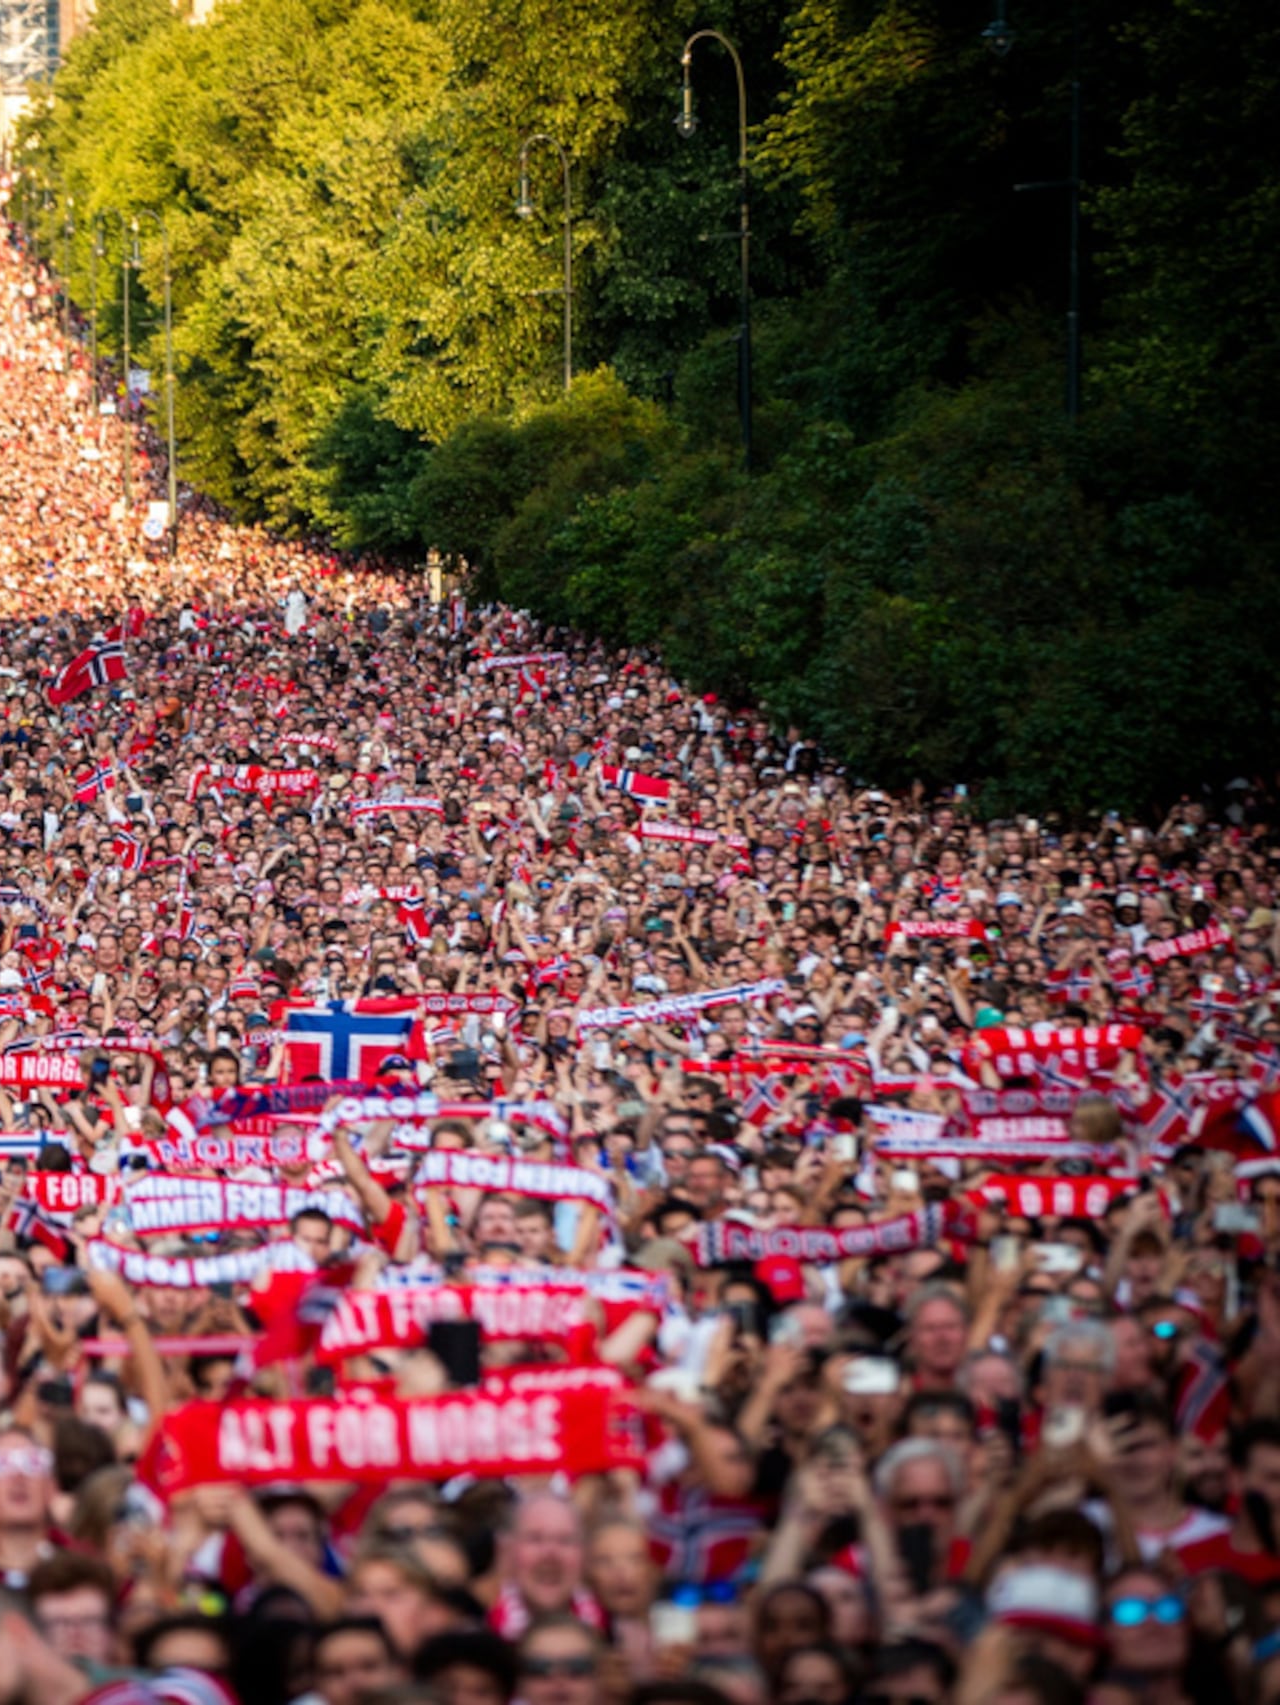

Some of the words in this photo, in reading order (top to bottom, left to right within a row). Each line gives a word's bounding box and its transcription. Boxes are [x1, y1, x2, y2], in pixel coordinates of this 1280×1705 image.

[579, 1006, 620, 1025] RGE
[21, 1056, 83, 1082] NORG
[157, 1135, 303, 1165] NORG
[44, 1174, 98, 1207] FOR
[219, 1408, 295, 1470] ALT
[308, 1405, 399, 1470] FOR
[410, 1397, 562, 1464] NORGE
